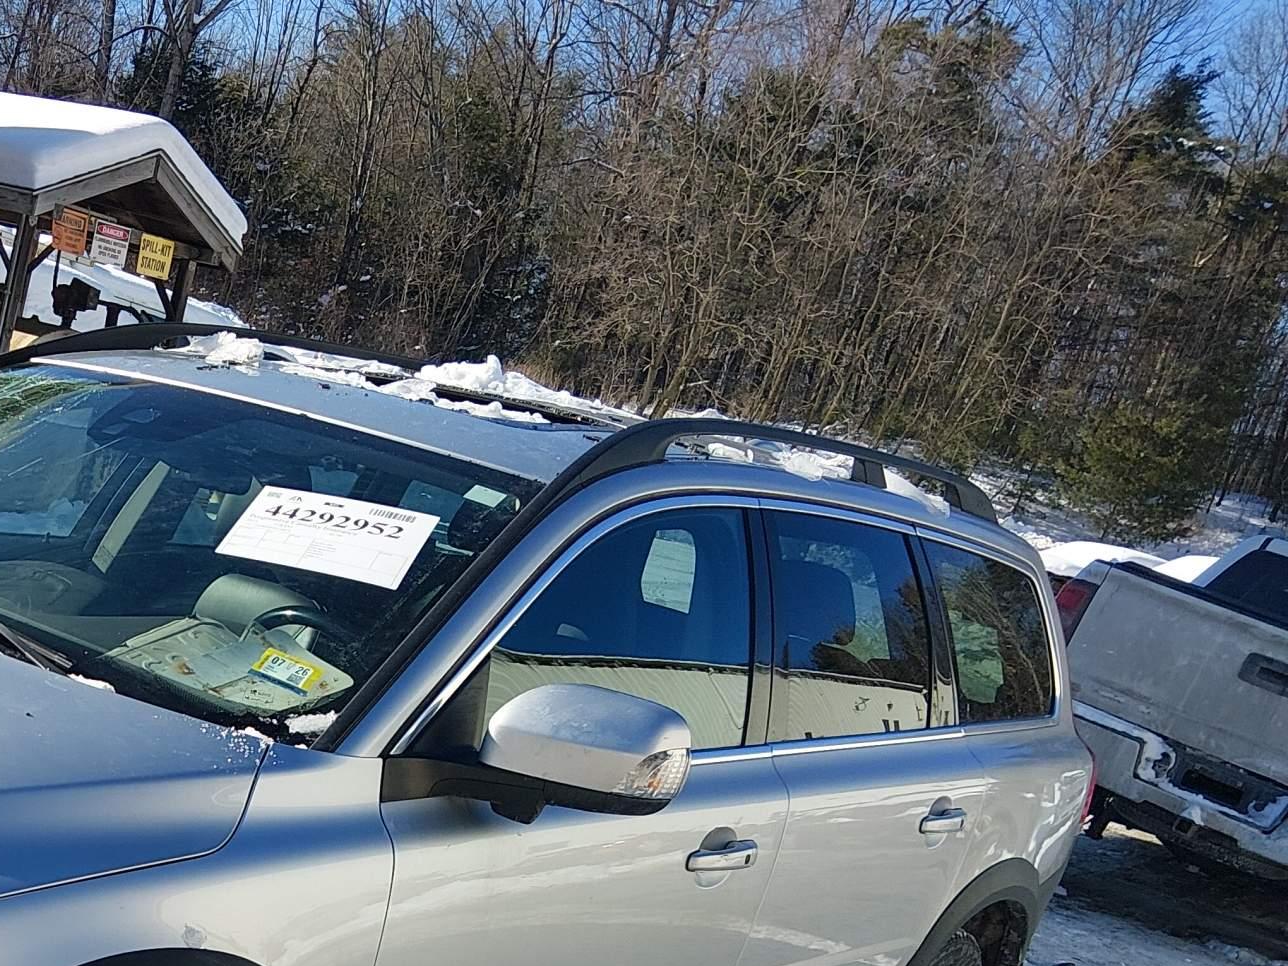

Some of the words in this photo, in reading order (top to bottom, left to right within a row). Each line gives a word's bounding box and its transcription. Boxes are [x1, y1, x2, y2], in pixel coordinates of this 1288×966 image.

[141, 238, 172, 257] SPILL-KIT
[140, 256, 166, 273] STATION
[265, 504, 404, 540] 44292952
[271, 656, 286, 667] 07
[294, 666, 310, 677] 26
